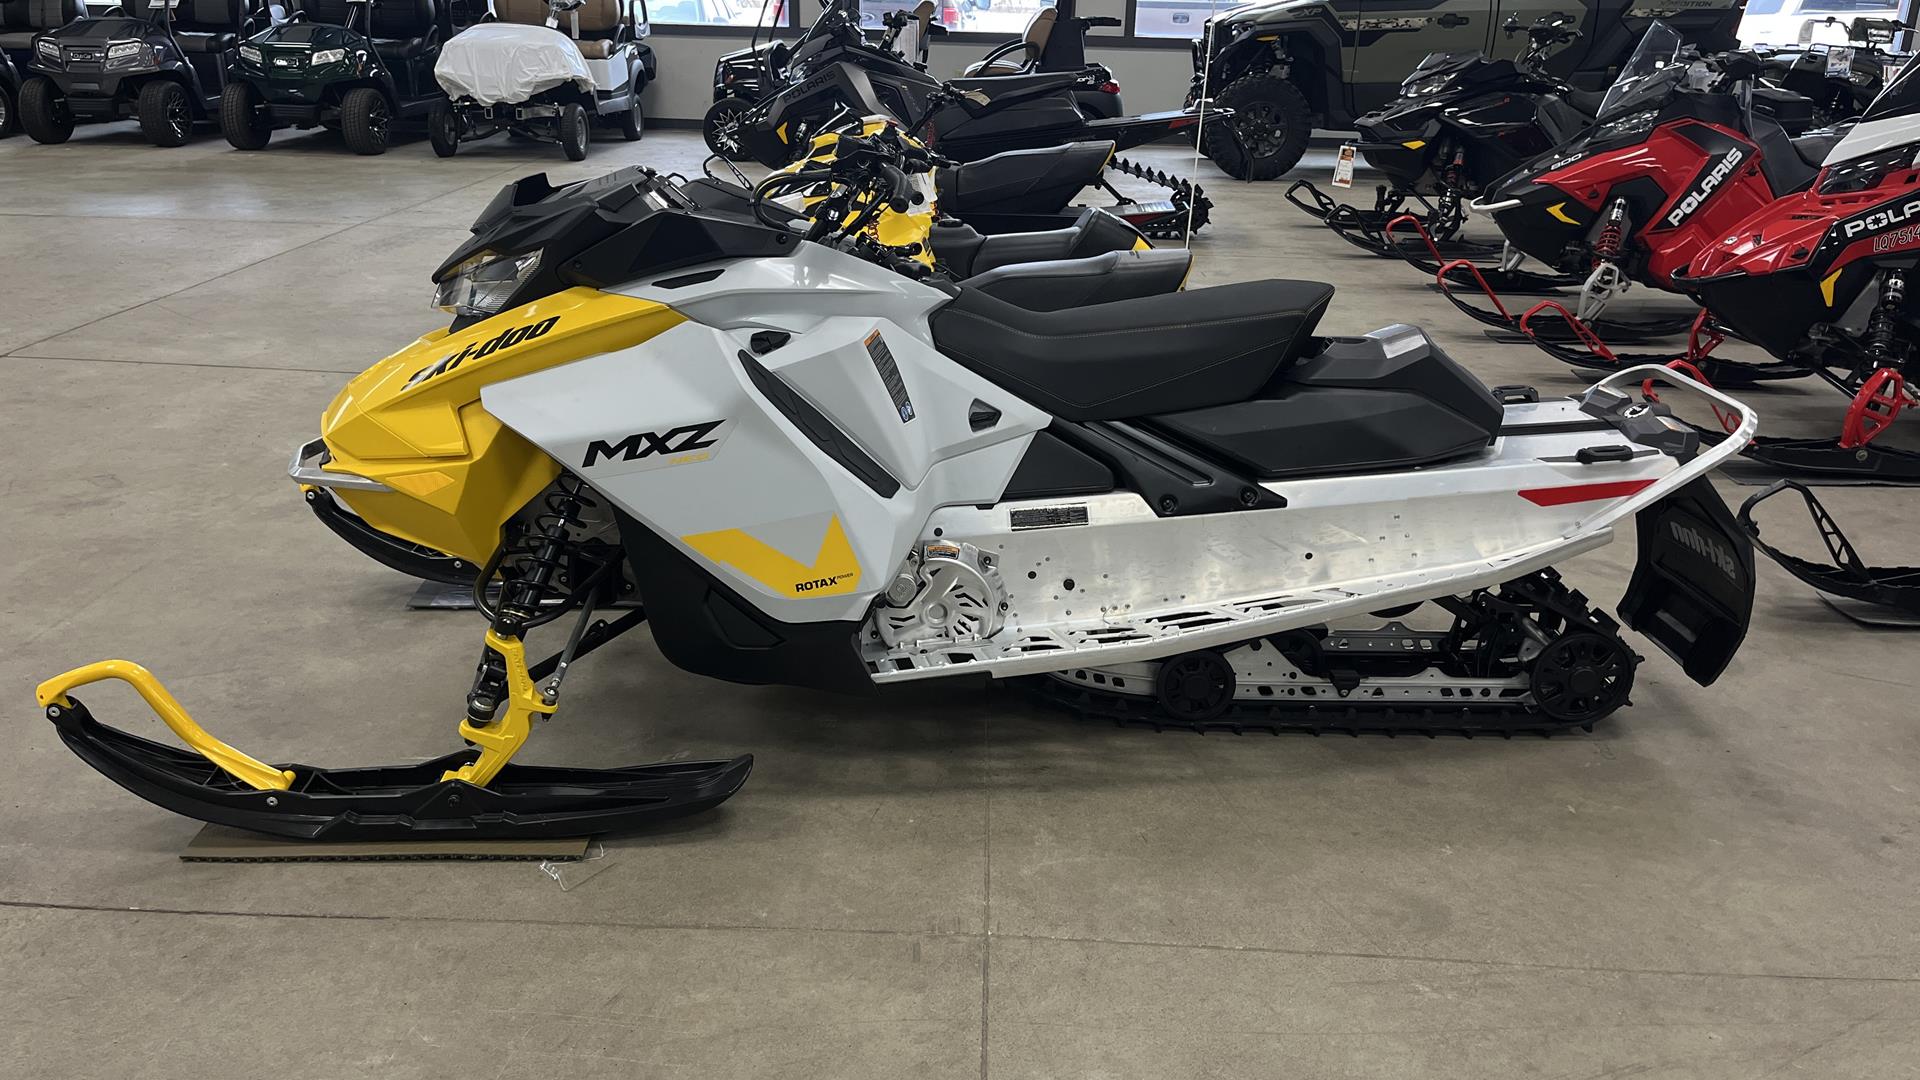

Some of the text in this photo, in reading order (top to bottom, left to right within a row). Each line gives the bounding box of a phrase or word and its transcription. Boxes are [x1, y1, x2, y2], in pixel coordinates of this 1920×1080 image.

[783, 70, 836, 103] POLARIS
[1551, 153, 1582, 170] 800
[1667, 147, 1743, 227] POLARIS
[582, 418, 727, 468] MXZ
[795, 577, 838, 592] ROTAX
